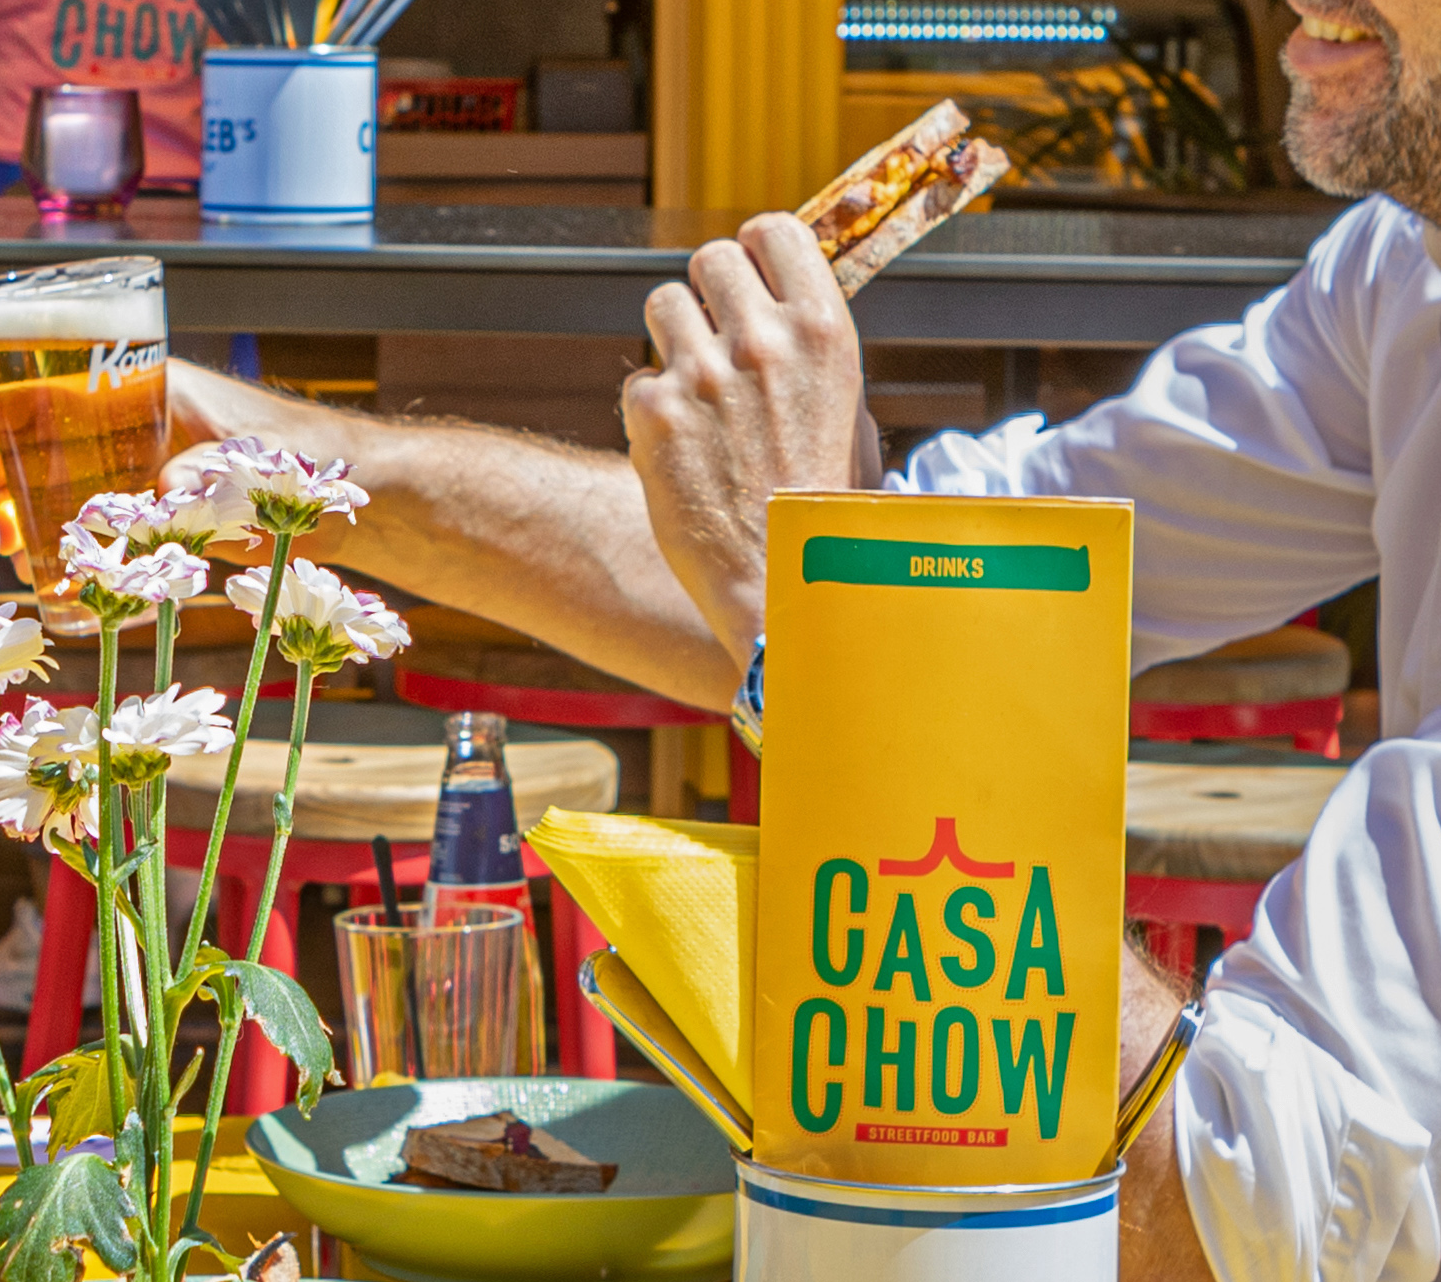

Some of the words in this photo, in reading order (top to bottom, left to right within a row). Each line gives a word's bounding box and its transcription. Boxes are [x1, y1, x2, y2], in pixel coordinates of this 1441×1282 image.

[910, 555, 984, 578] DRINKS
[812, 857, 1066, 1003] CASA
[790, 996, 1077, 1141] CHOW
[868, 1126, 960, 1144] STREETFOOD
[967, 1130, 996, 1144] BAR
